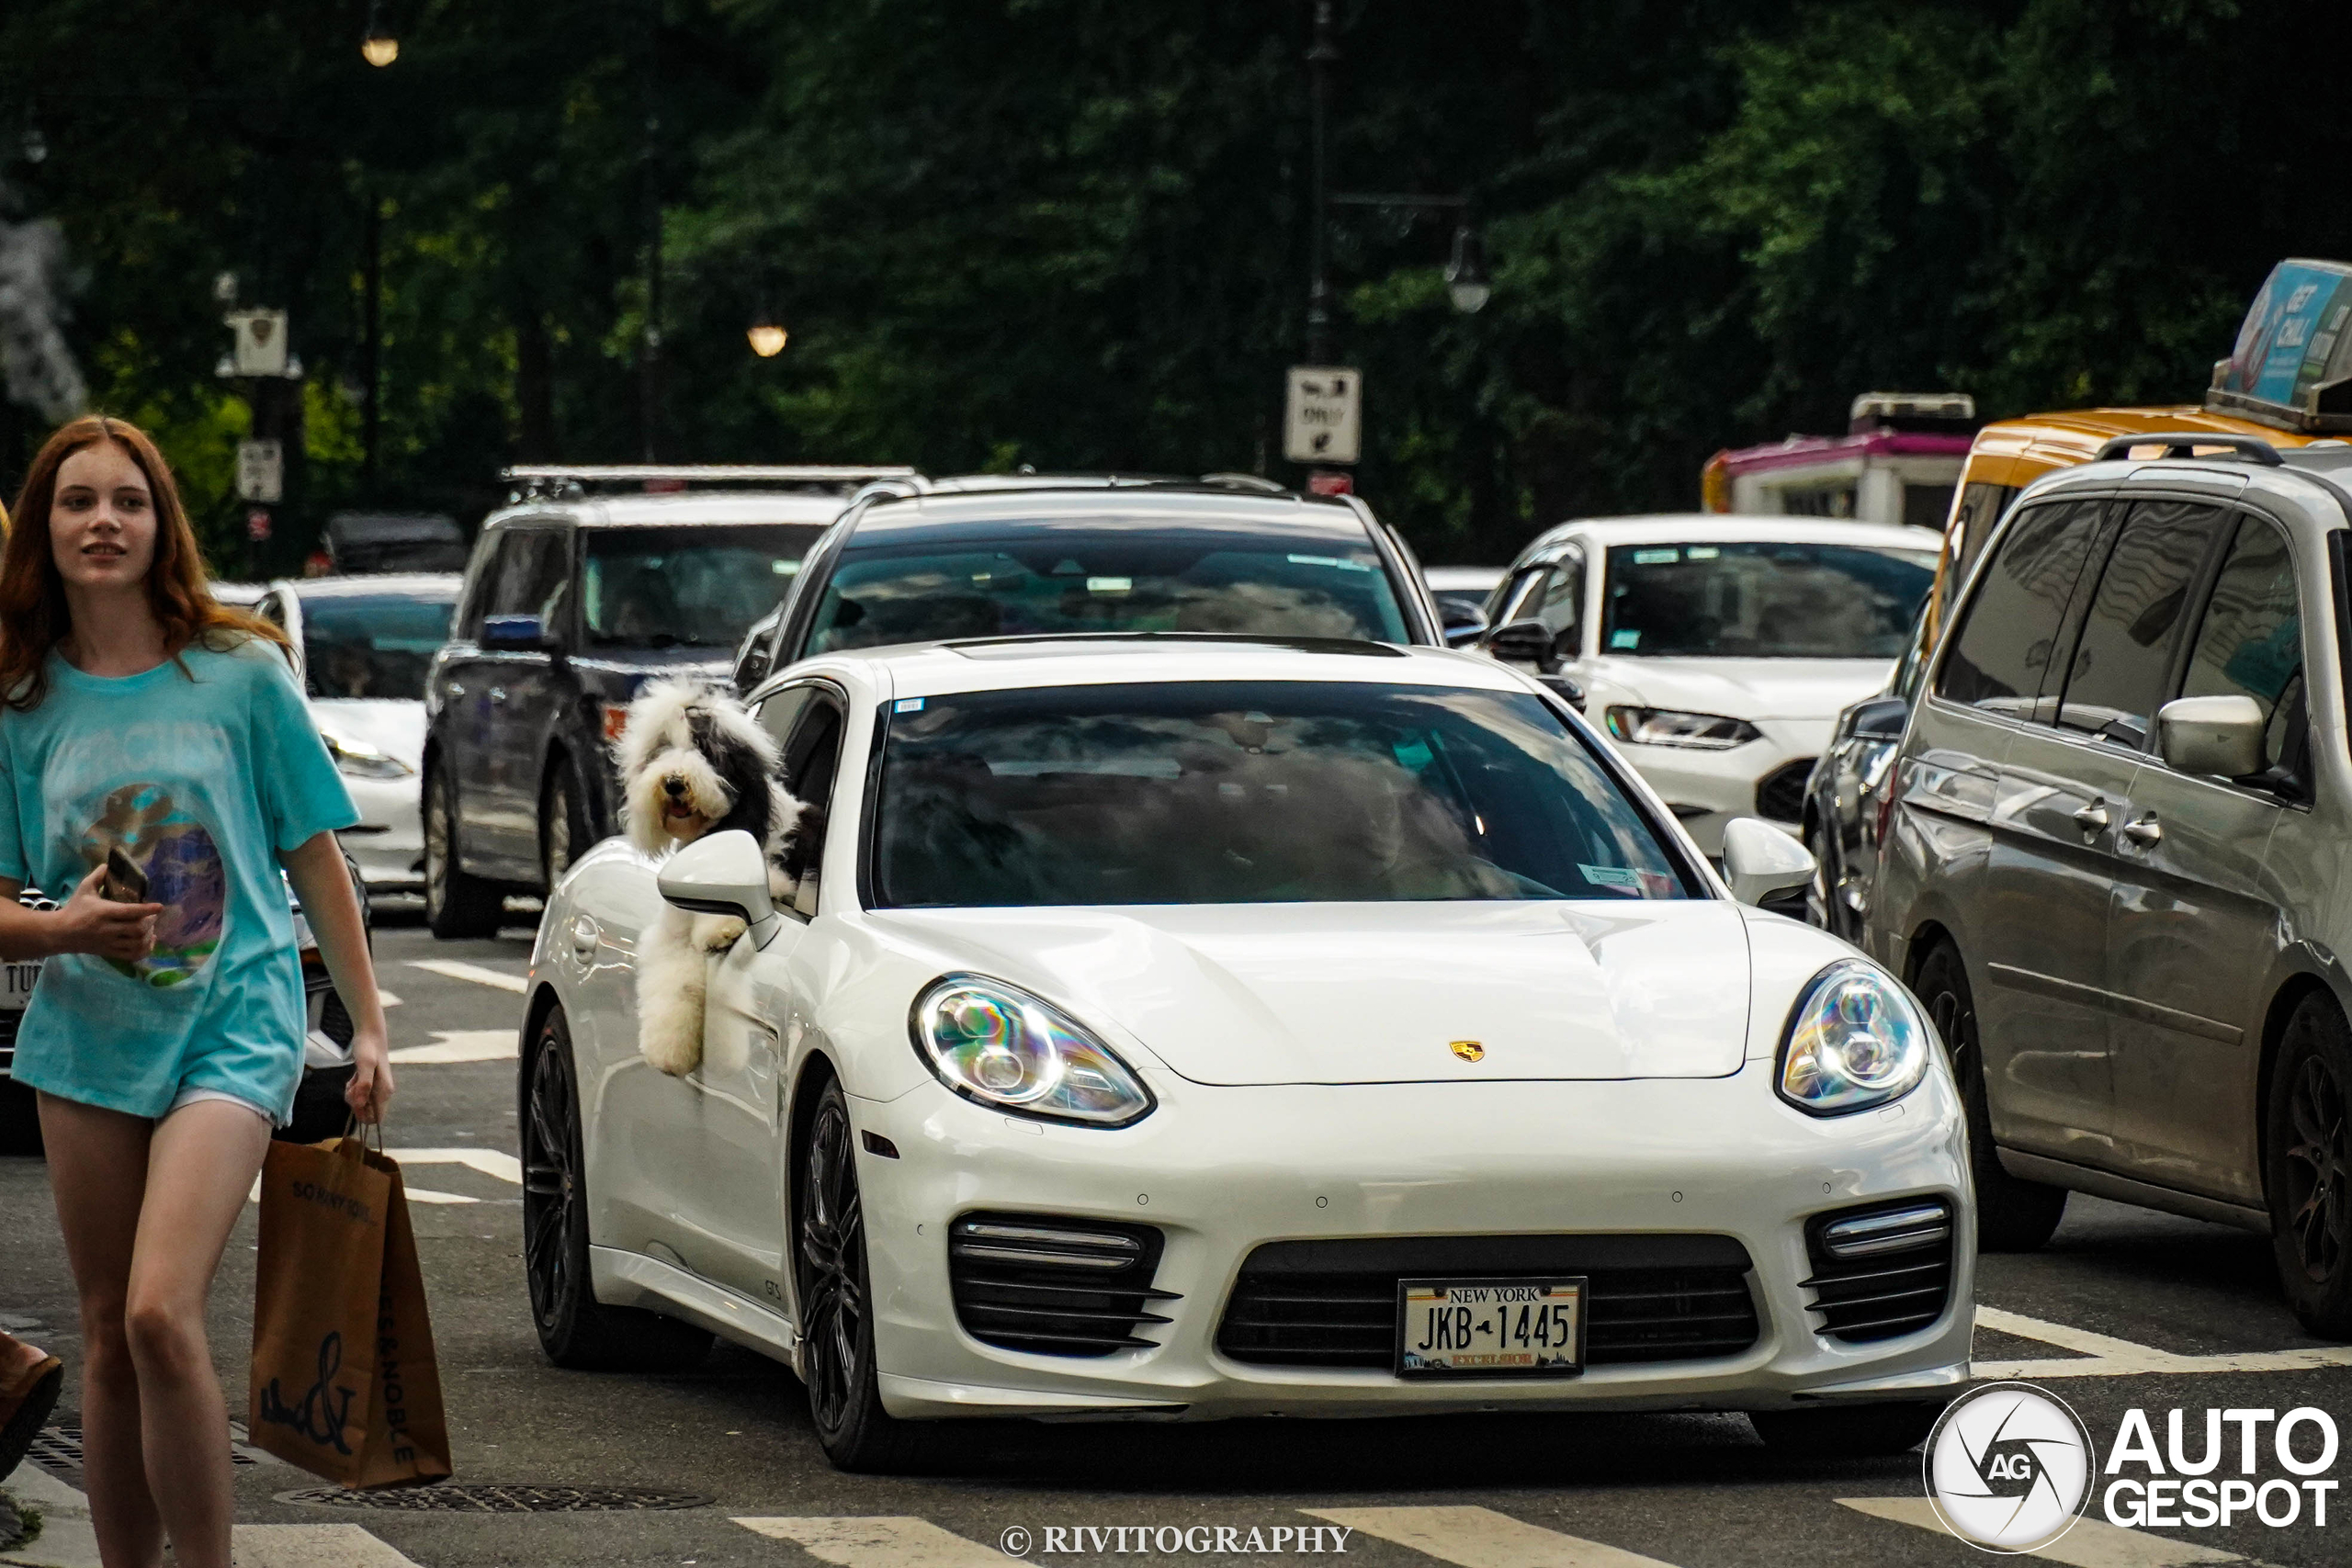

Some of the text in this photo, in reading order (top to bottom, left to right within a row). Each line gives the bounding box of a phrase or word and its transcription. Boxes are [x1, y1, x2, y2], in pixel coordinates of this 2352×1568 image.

[1450, 1288, 1540, 1304] NEW YORK
[1418, 1304, 1569, 1350] JKB 1445
